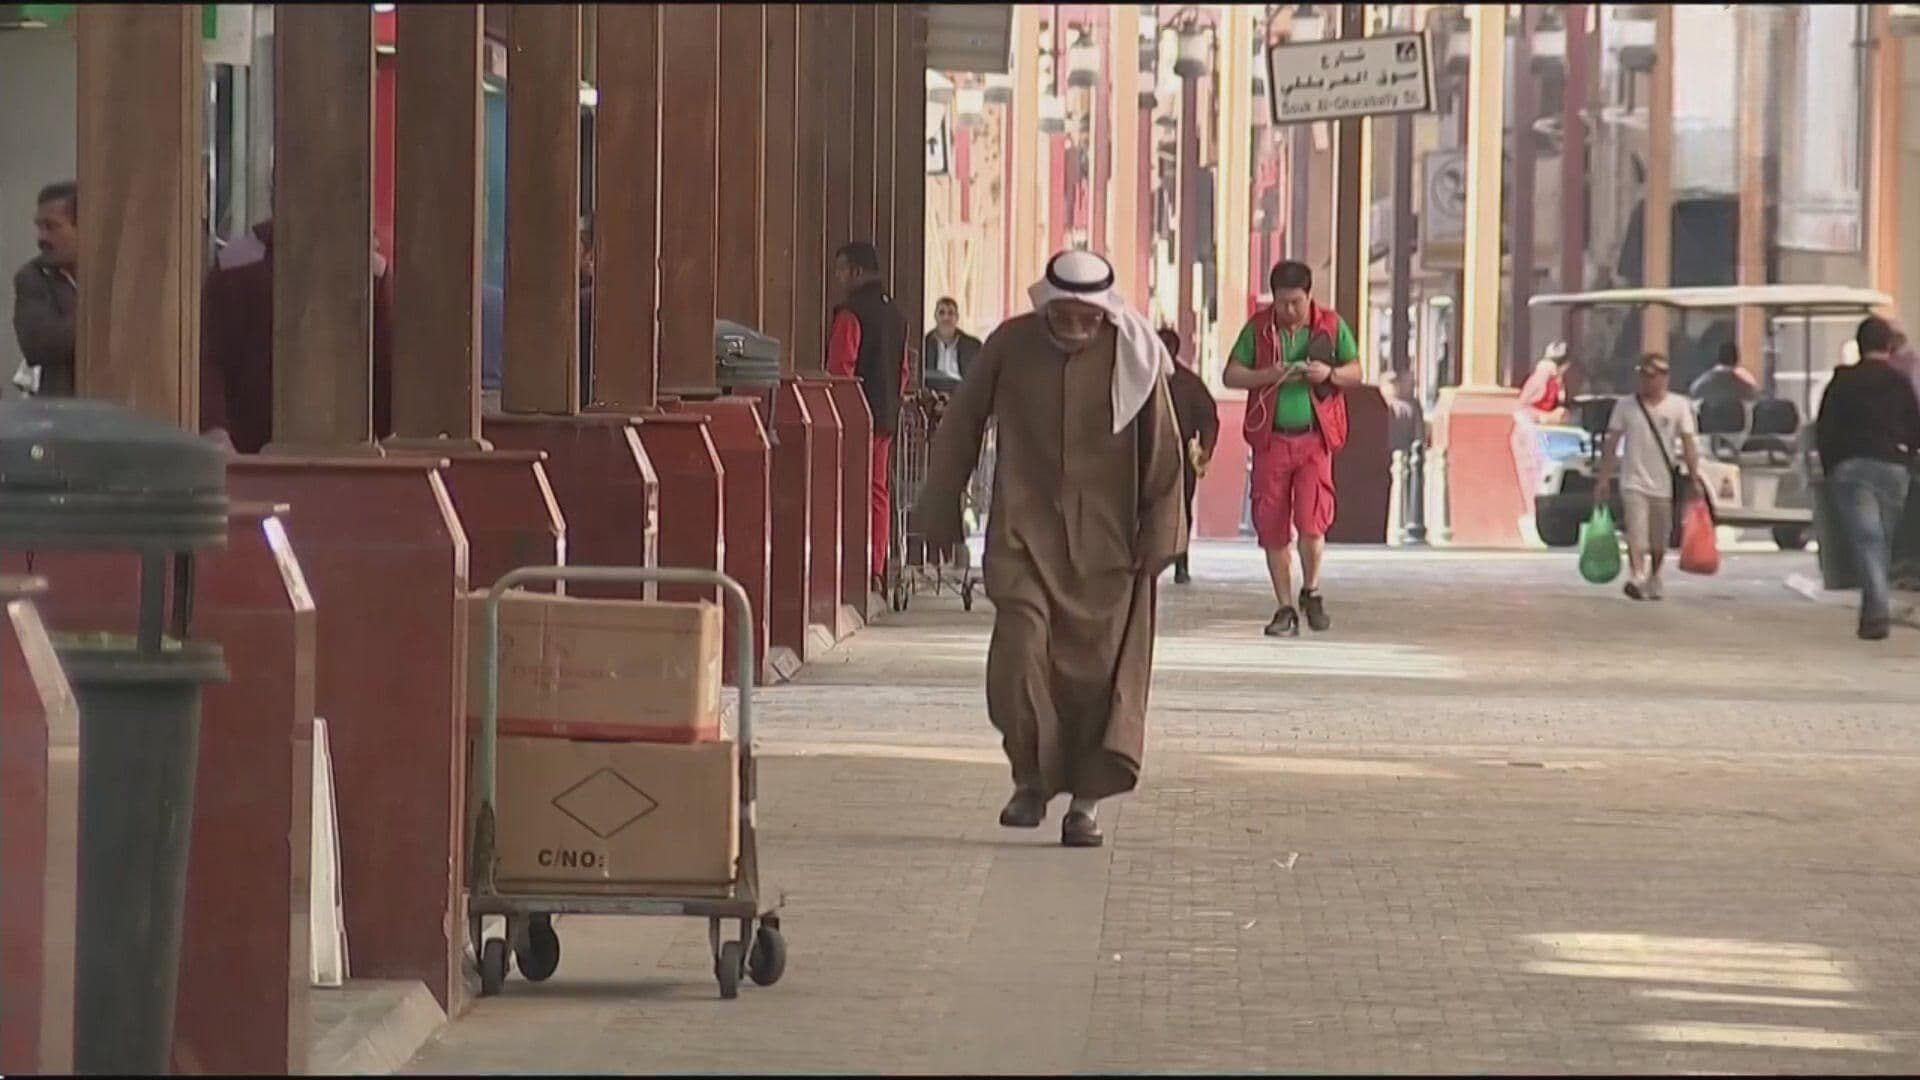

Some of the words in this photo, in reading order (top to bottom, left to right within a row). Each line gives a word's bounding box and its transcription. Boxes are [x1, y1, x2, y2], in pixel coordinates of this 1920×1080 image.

[1321, 48, 1365, 69] شارع
[1281, 101, 1310, 115] Souk
[538, 848, 605, 868] C/NO:
